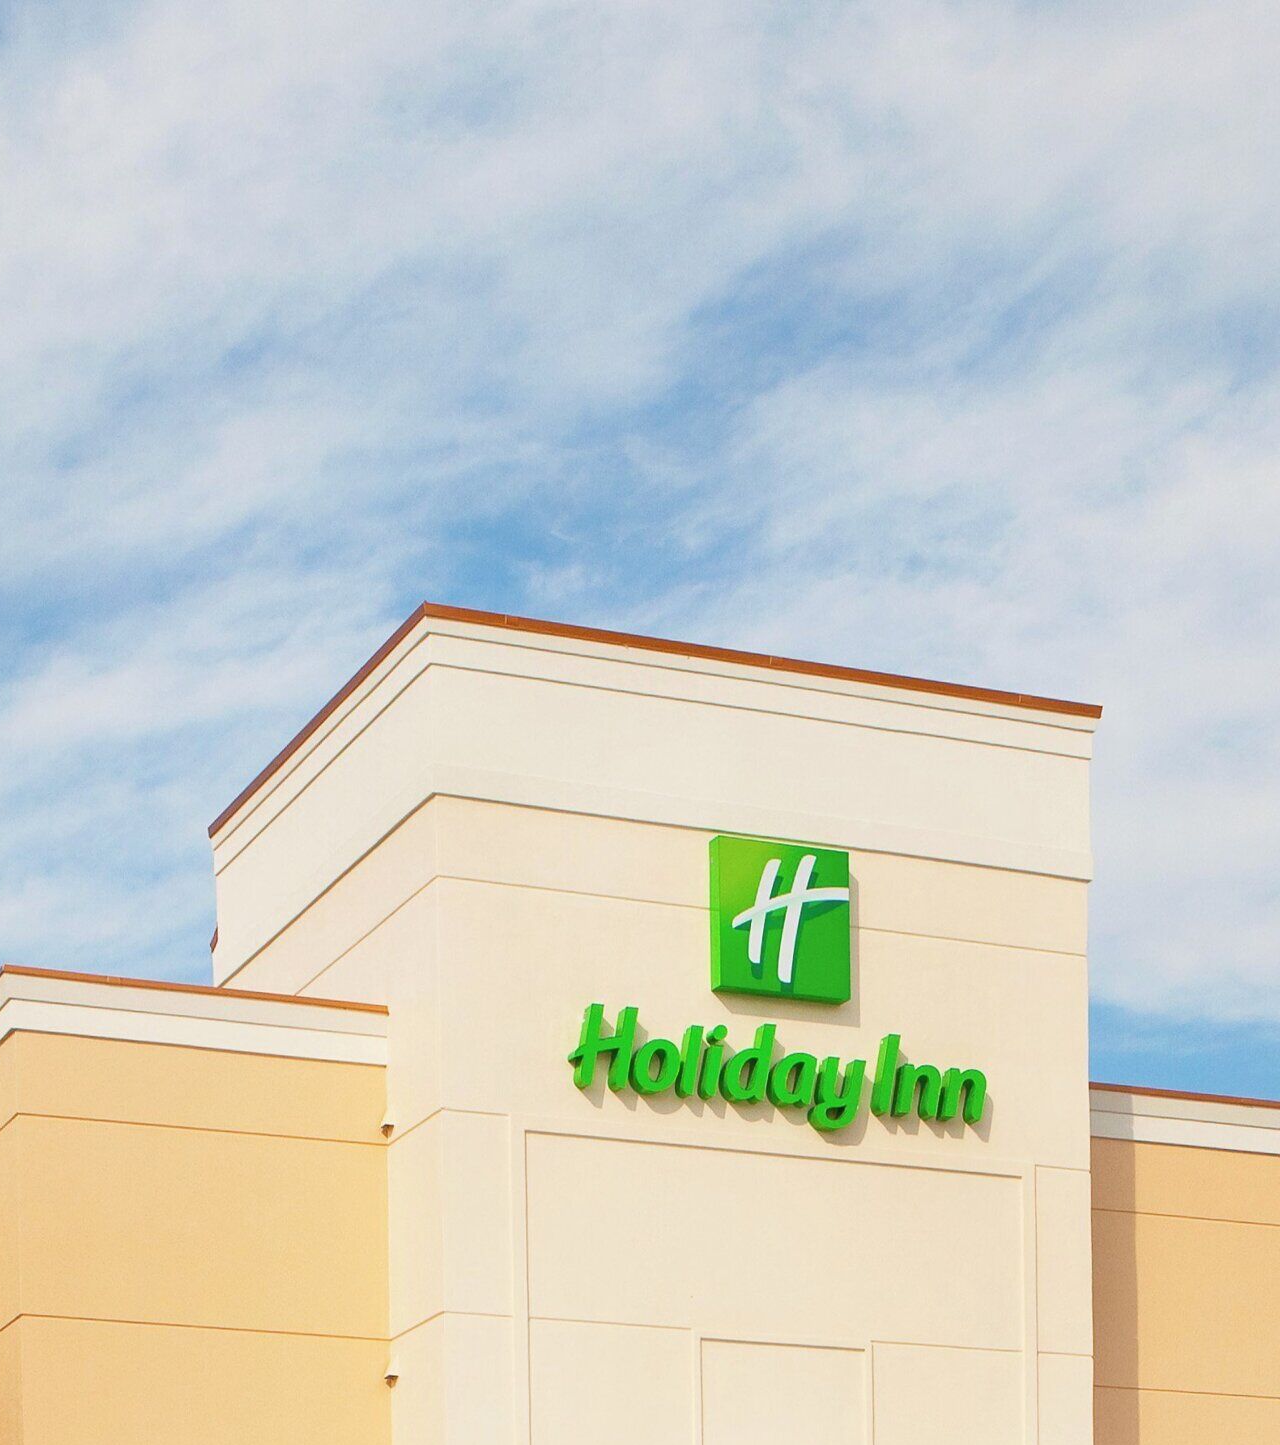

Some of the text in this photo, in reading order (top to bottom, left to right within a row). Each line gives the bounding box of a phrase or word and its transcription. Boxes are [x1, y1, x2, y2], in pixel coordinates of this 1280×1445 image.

[732, 855, 849, 983] H
[569, 1003, 987, 1131] Holiday Inn
